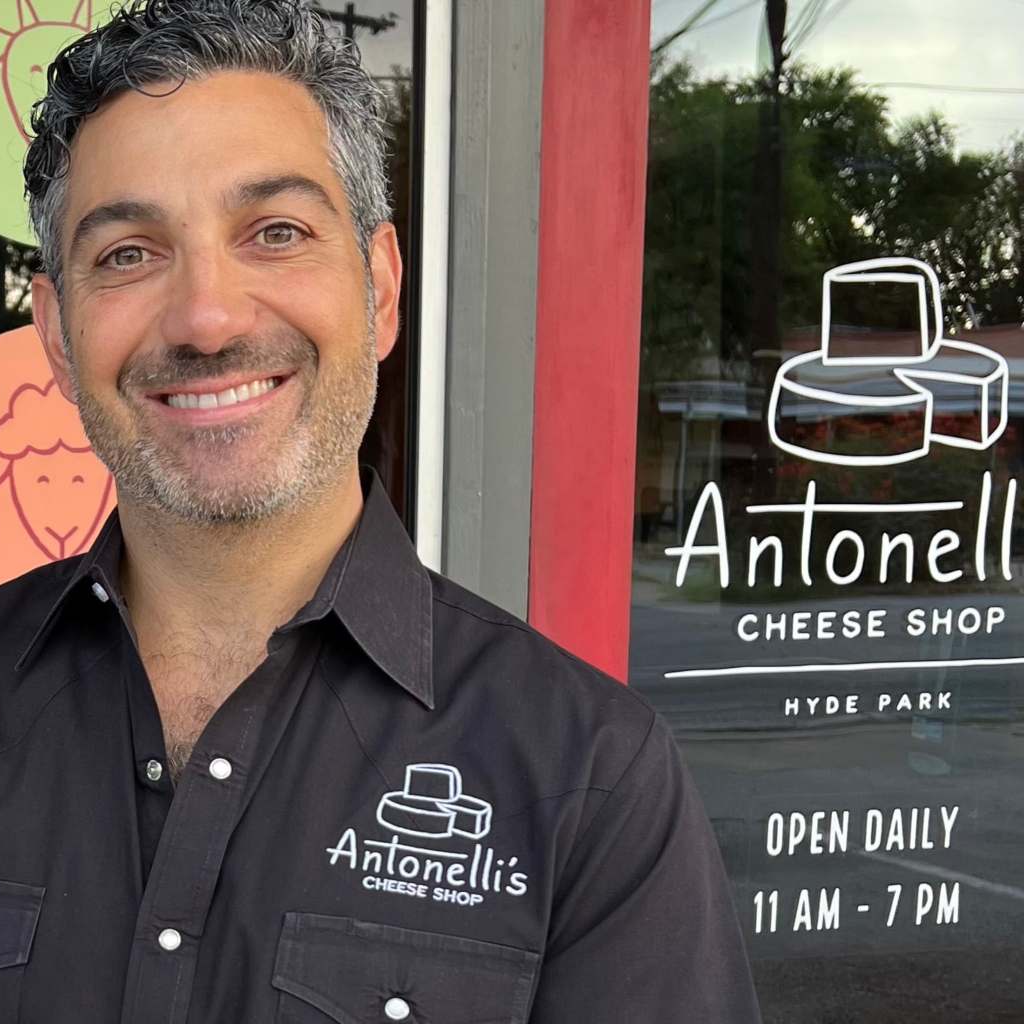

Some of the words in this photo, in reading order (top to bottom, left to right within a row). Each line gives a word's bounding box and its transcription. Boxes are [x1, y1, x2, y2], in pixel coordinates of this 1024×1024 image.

[737, 609, 887, 642] CHEESE
[906, 606, 1006, 637] SHOP
[784, 695, 859, 716] HYDE
[878, 691, 951, 712] PARK
[766, 810, 850, 857] OPEN
[864, 806, 959, 852] DAILY
[326, 827, 528, 896] Antonelli's
[362, 875, 429, 899] CHEESE
[432, 886, 484, 907] SHOP
[753, 889, 778, 934] 11
[792, 887, 840, 932] AM
[886, 884, 902, 927] 7
[915, 882, 960, 926] PM
